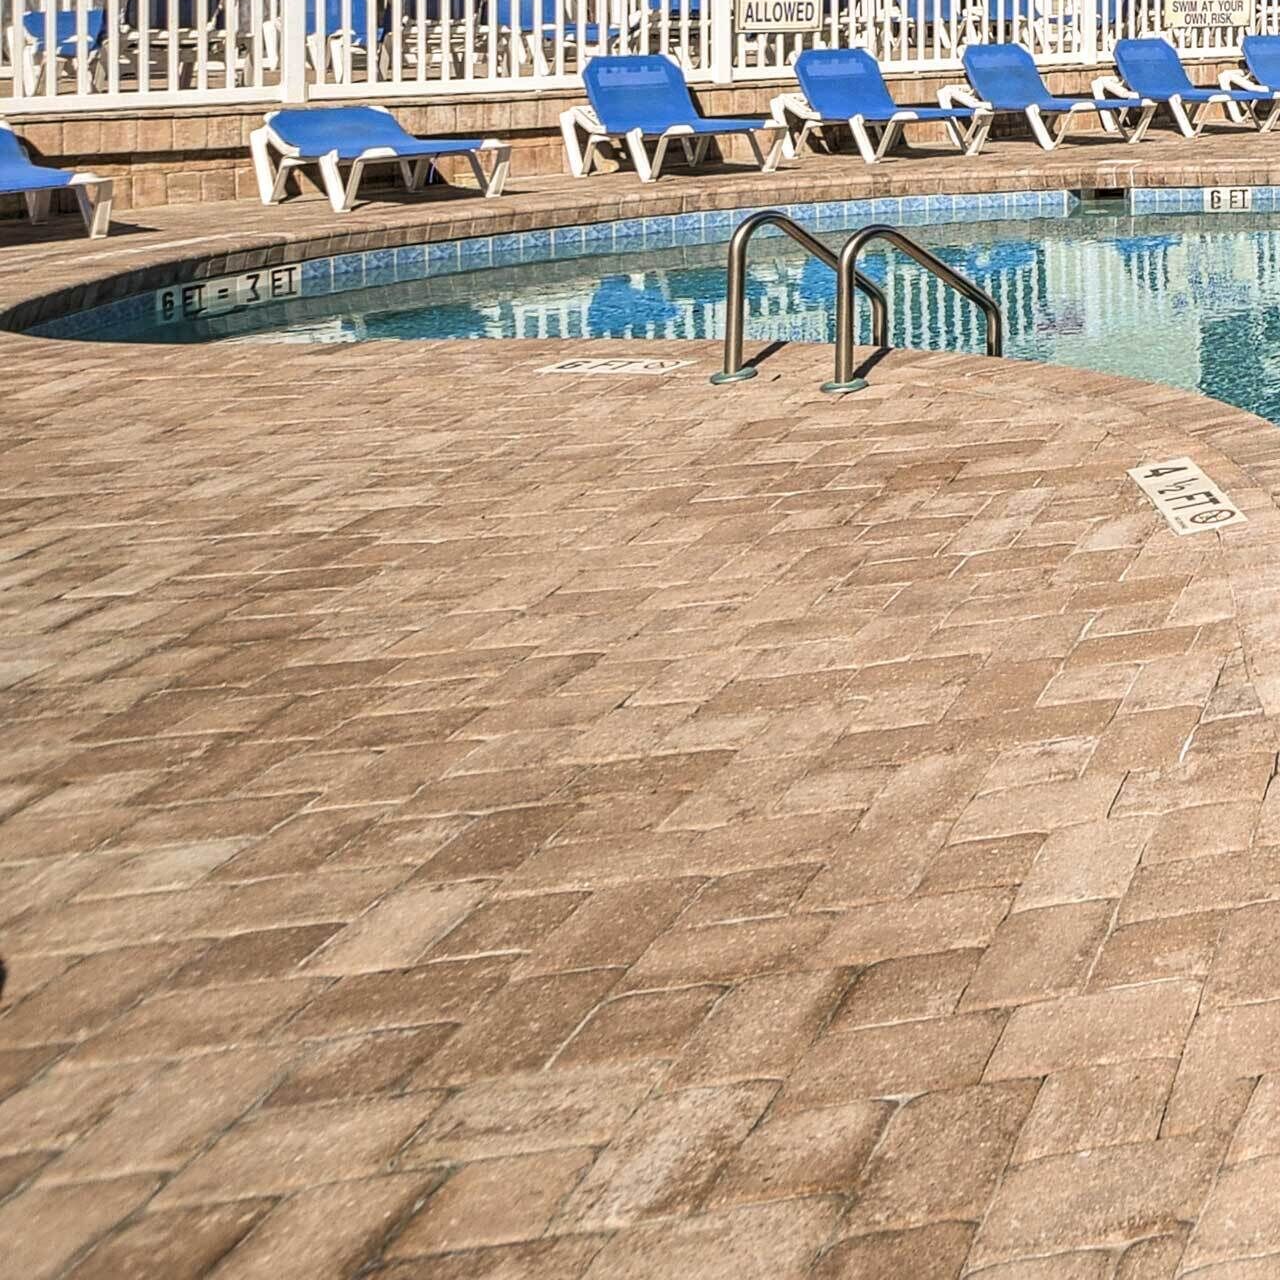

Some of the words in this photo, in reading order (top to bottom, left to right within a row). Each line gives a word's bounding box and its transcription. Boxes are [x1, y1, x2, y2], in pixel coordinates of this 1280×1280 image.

[744, 1, 815, 23] ALLOWED
[1172, 0, 1197, 13] SWIM
[1201, 1, 1214, 12] AT
[1218, 0, 1244, 12] YOUR
[1184, 13, 1207, 25] OWN
[1211, 12, 1233, 25] RISK
[1143, 466, 1188, 479] 4
[1164, 490, 1221, 511] FT
